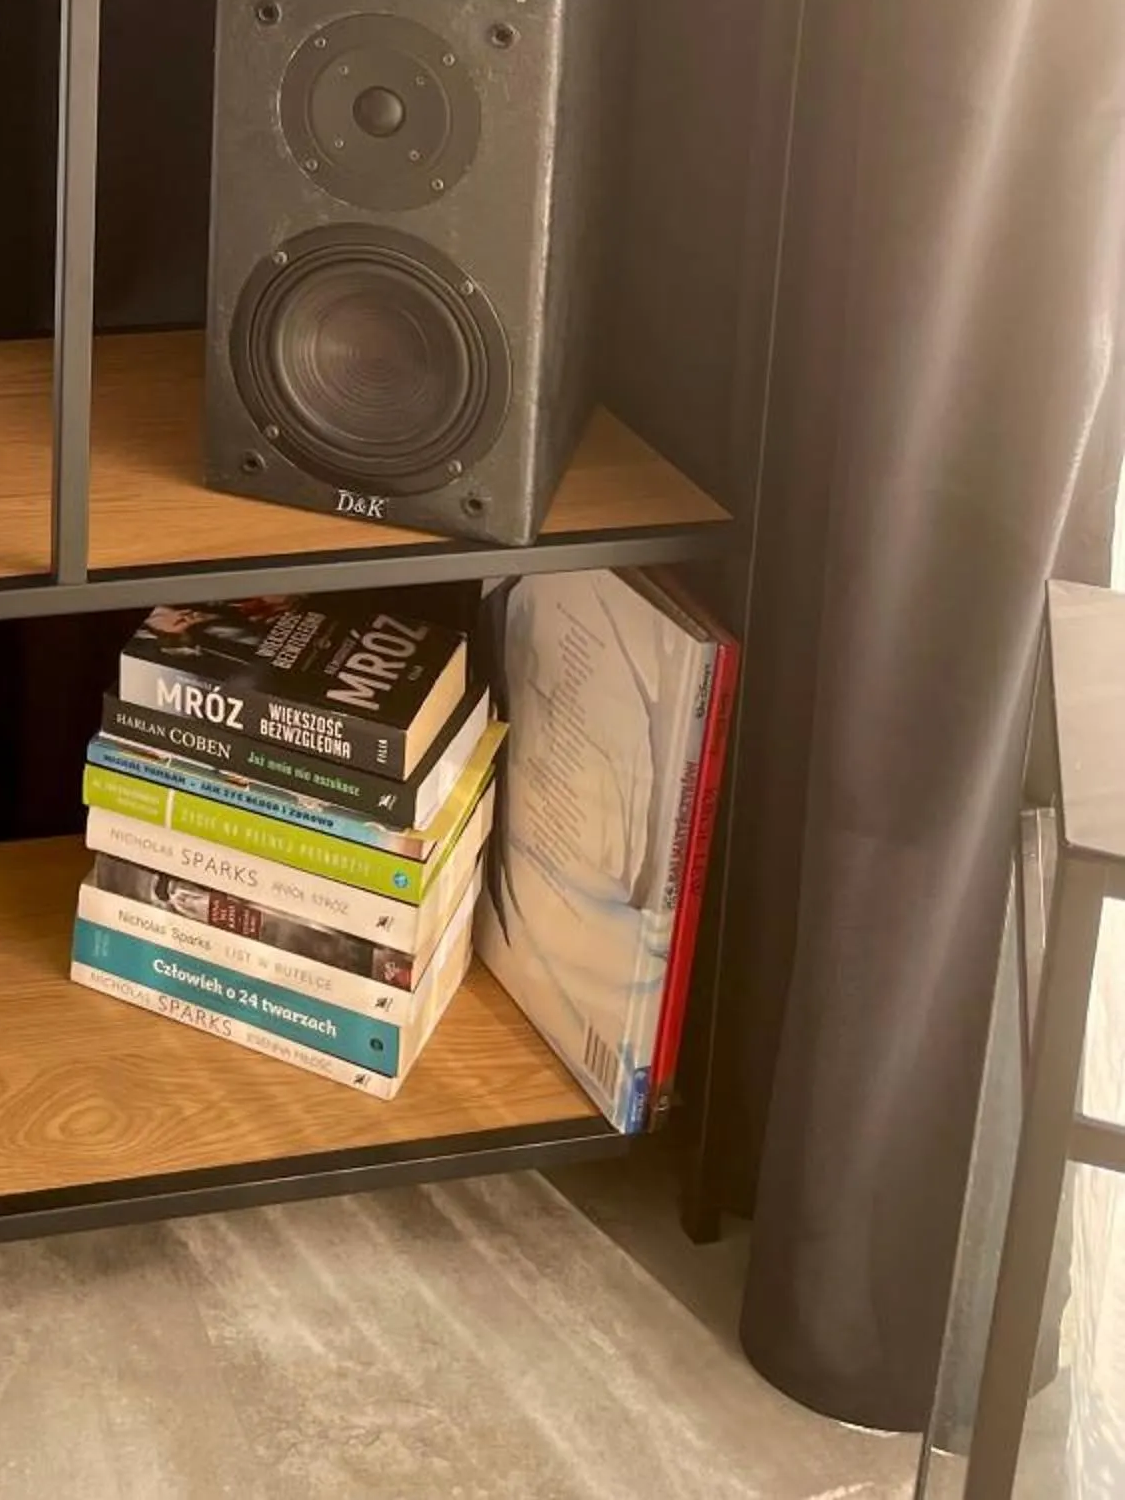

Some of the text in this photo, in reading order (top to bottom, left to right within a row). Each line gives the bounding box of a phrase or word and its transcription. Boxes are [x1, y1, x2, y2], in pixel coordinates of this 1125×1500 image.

[335, 489, 385, 519] D&K
[326, 614, 429, 711] MRÓZ
[156, 676, 244, 730] MRÓZ
[115, 713, 232, 760] HARLAN COBEN
[260, 719, 351, 759] BEZWZGLĘDNA
[110, 827, 173, 856] NICHOLAS
[181, 848, 259, 887] SPARKS
[117, 909, 166, 935] Nicholas
[171, 927, 212, 951] Sparks
[153, 958, 338, 1039] Człowiek o 24 twarzach
[157, 995, 233, 1037] SPARKS
